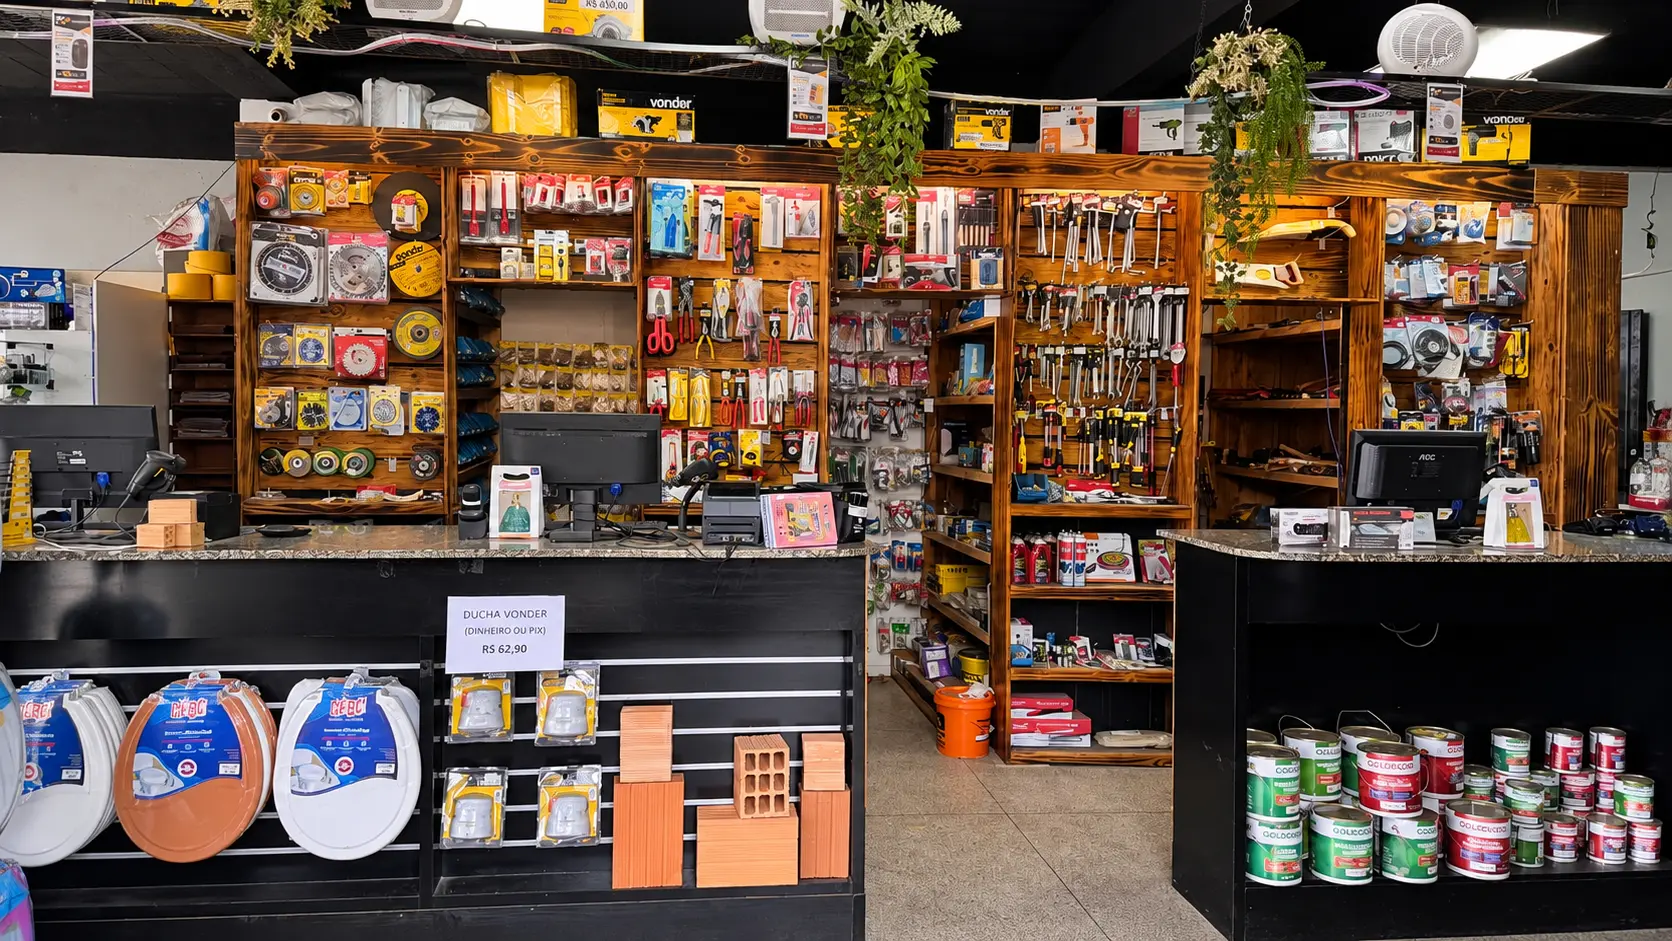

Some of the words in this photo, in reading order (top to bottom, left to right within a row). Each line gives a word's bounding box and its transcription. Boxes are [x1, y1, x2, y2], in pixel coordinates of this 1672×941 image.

[650, 96, 692, 109] vonder
[463, 610, 501, 619] DUCHA
[504, 609, 548, 619] VONDER
[464, 627, 511, 636] (DINHEIRO
[513, 626, 527, 635] OU
[529, 626, 546, 636] PIX)
[498, 644, 528, 655] 62,90
